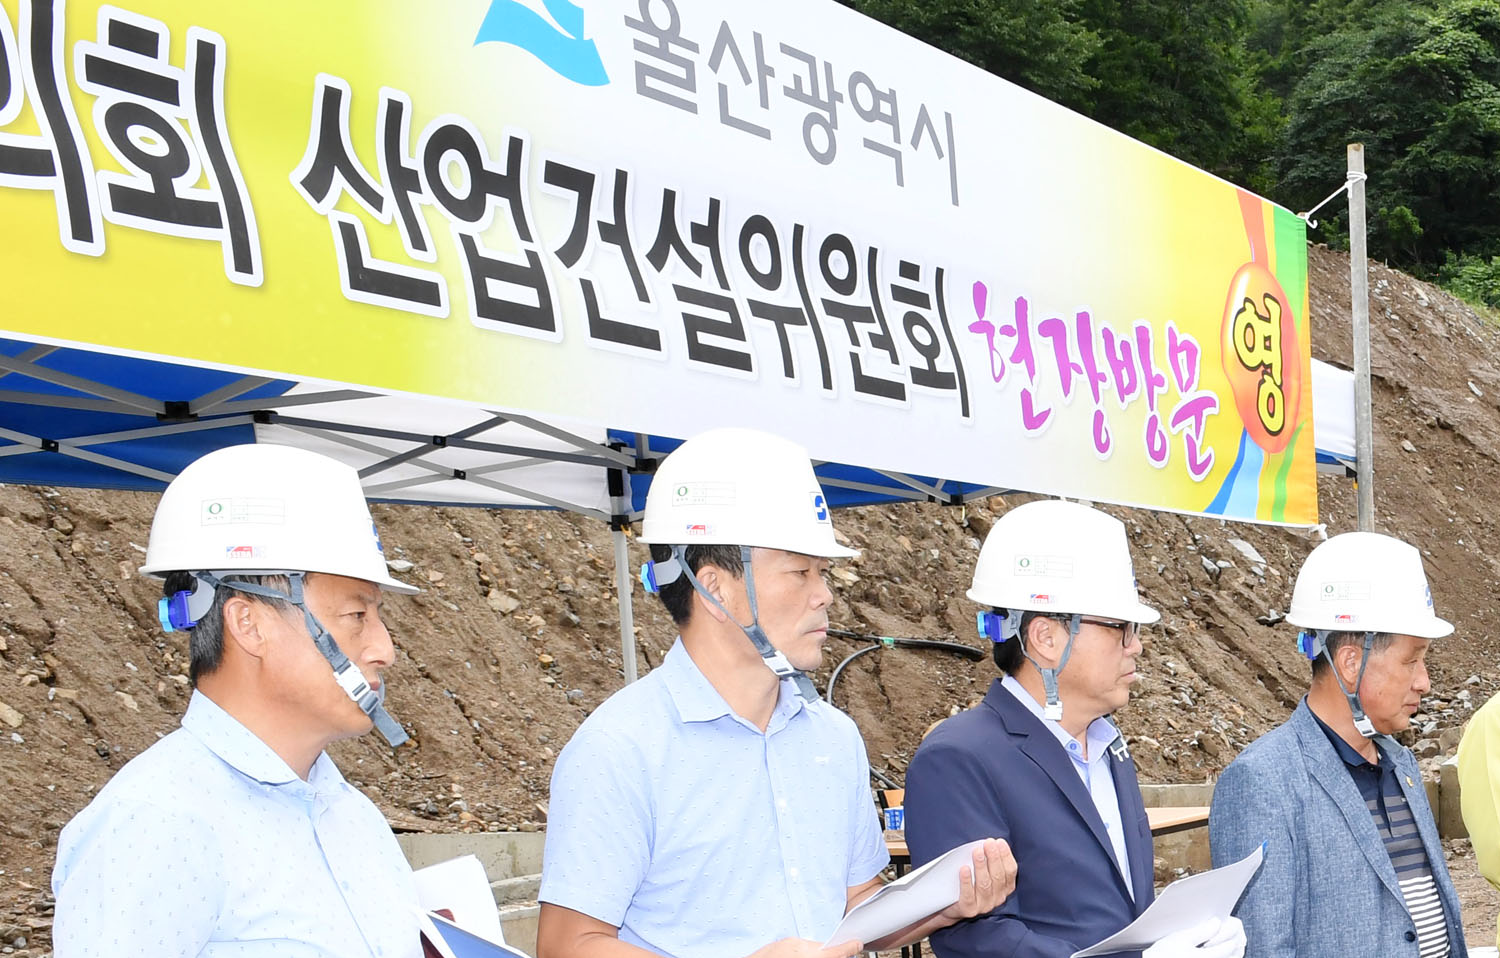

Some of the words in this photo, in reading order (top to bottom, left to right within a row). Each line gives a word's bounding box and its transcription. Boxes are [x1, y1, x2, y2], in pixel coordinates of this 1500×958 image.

[624, 0, 960, 206] 울산광역시
[300, 84, 971, 418] 산업건설위원회
[967, 281, 1219, 477] 현장방문
